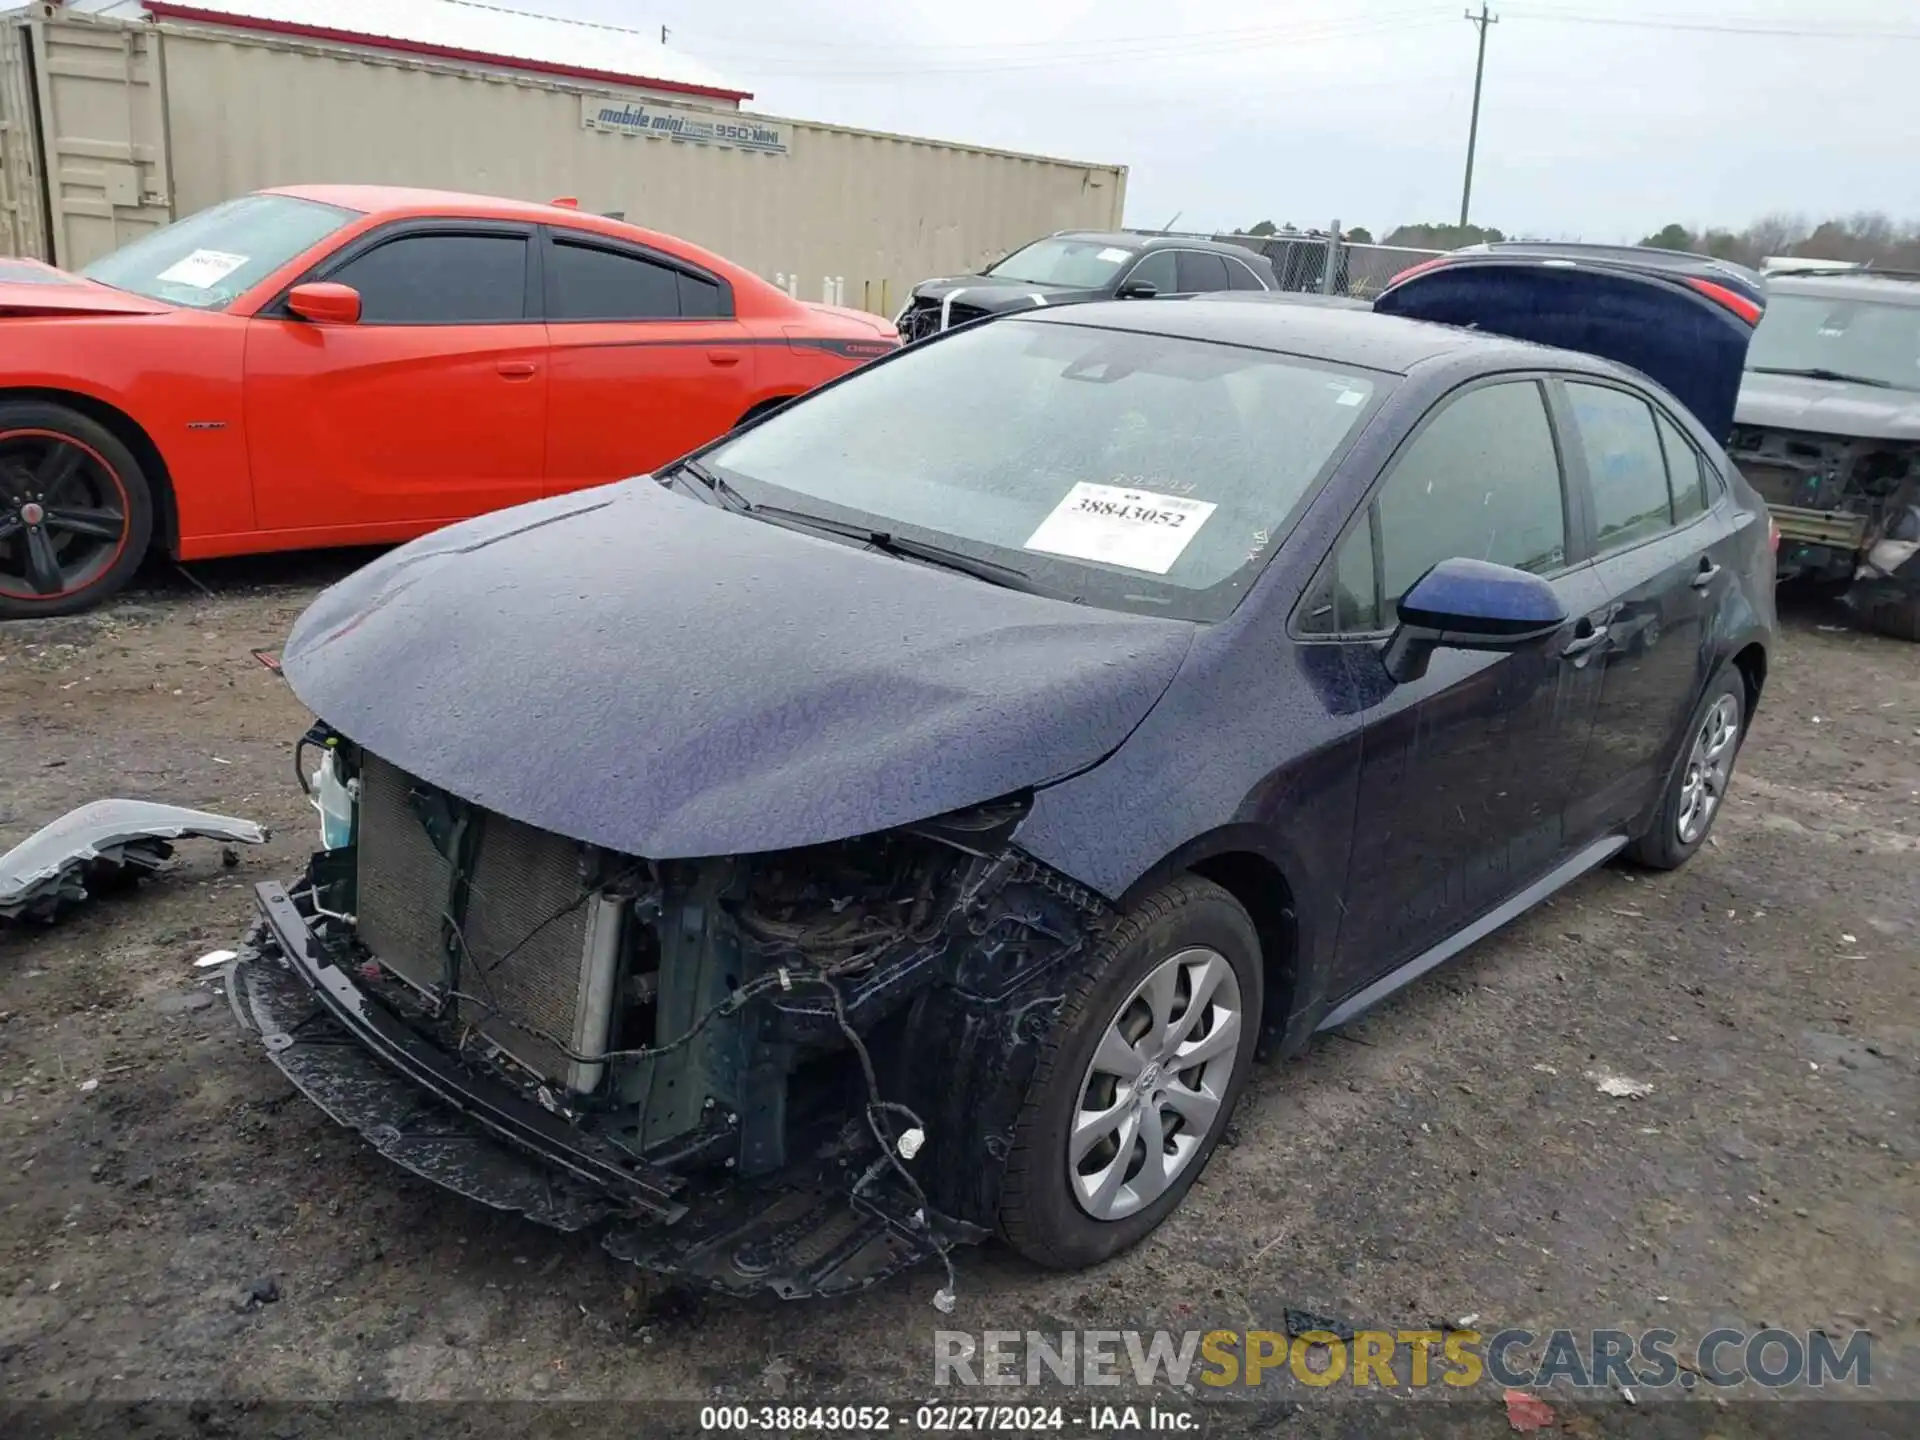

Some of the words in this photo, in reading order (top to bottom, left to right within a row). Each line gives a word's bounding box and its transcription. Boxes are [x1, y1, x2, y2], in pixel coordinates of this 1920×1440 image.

[598, 104, 650, 127] mobile
[651, 114, 685, 133] mini
[1072, 498, 1186, 527] 38843052
